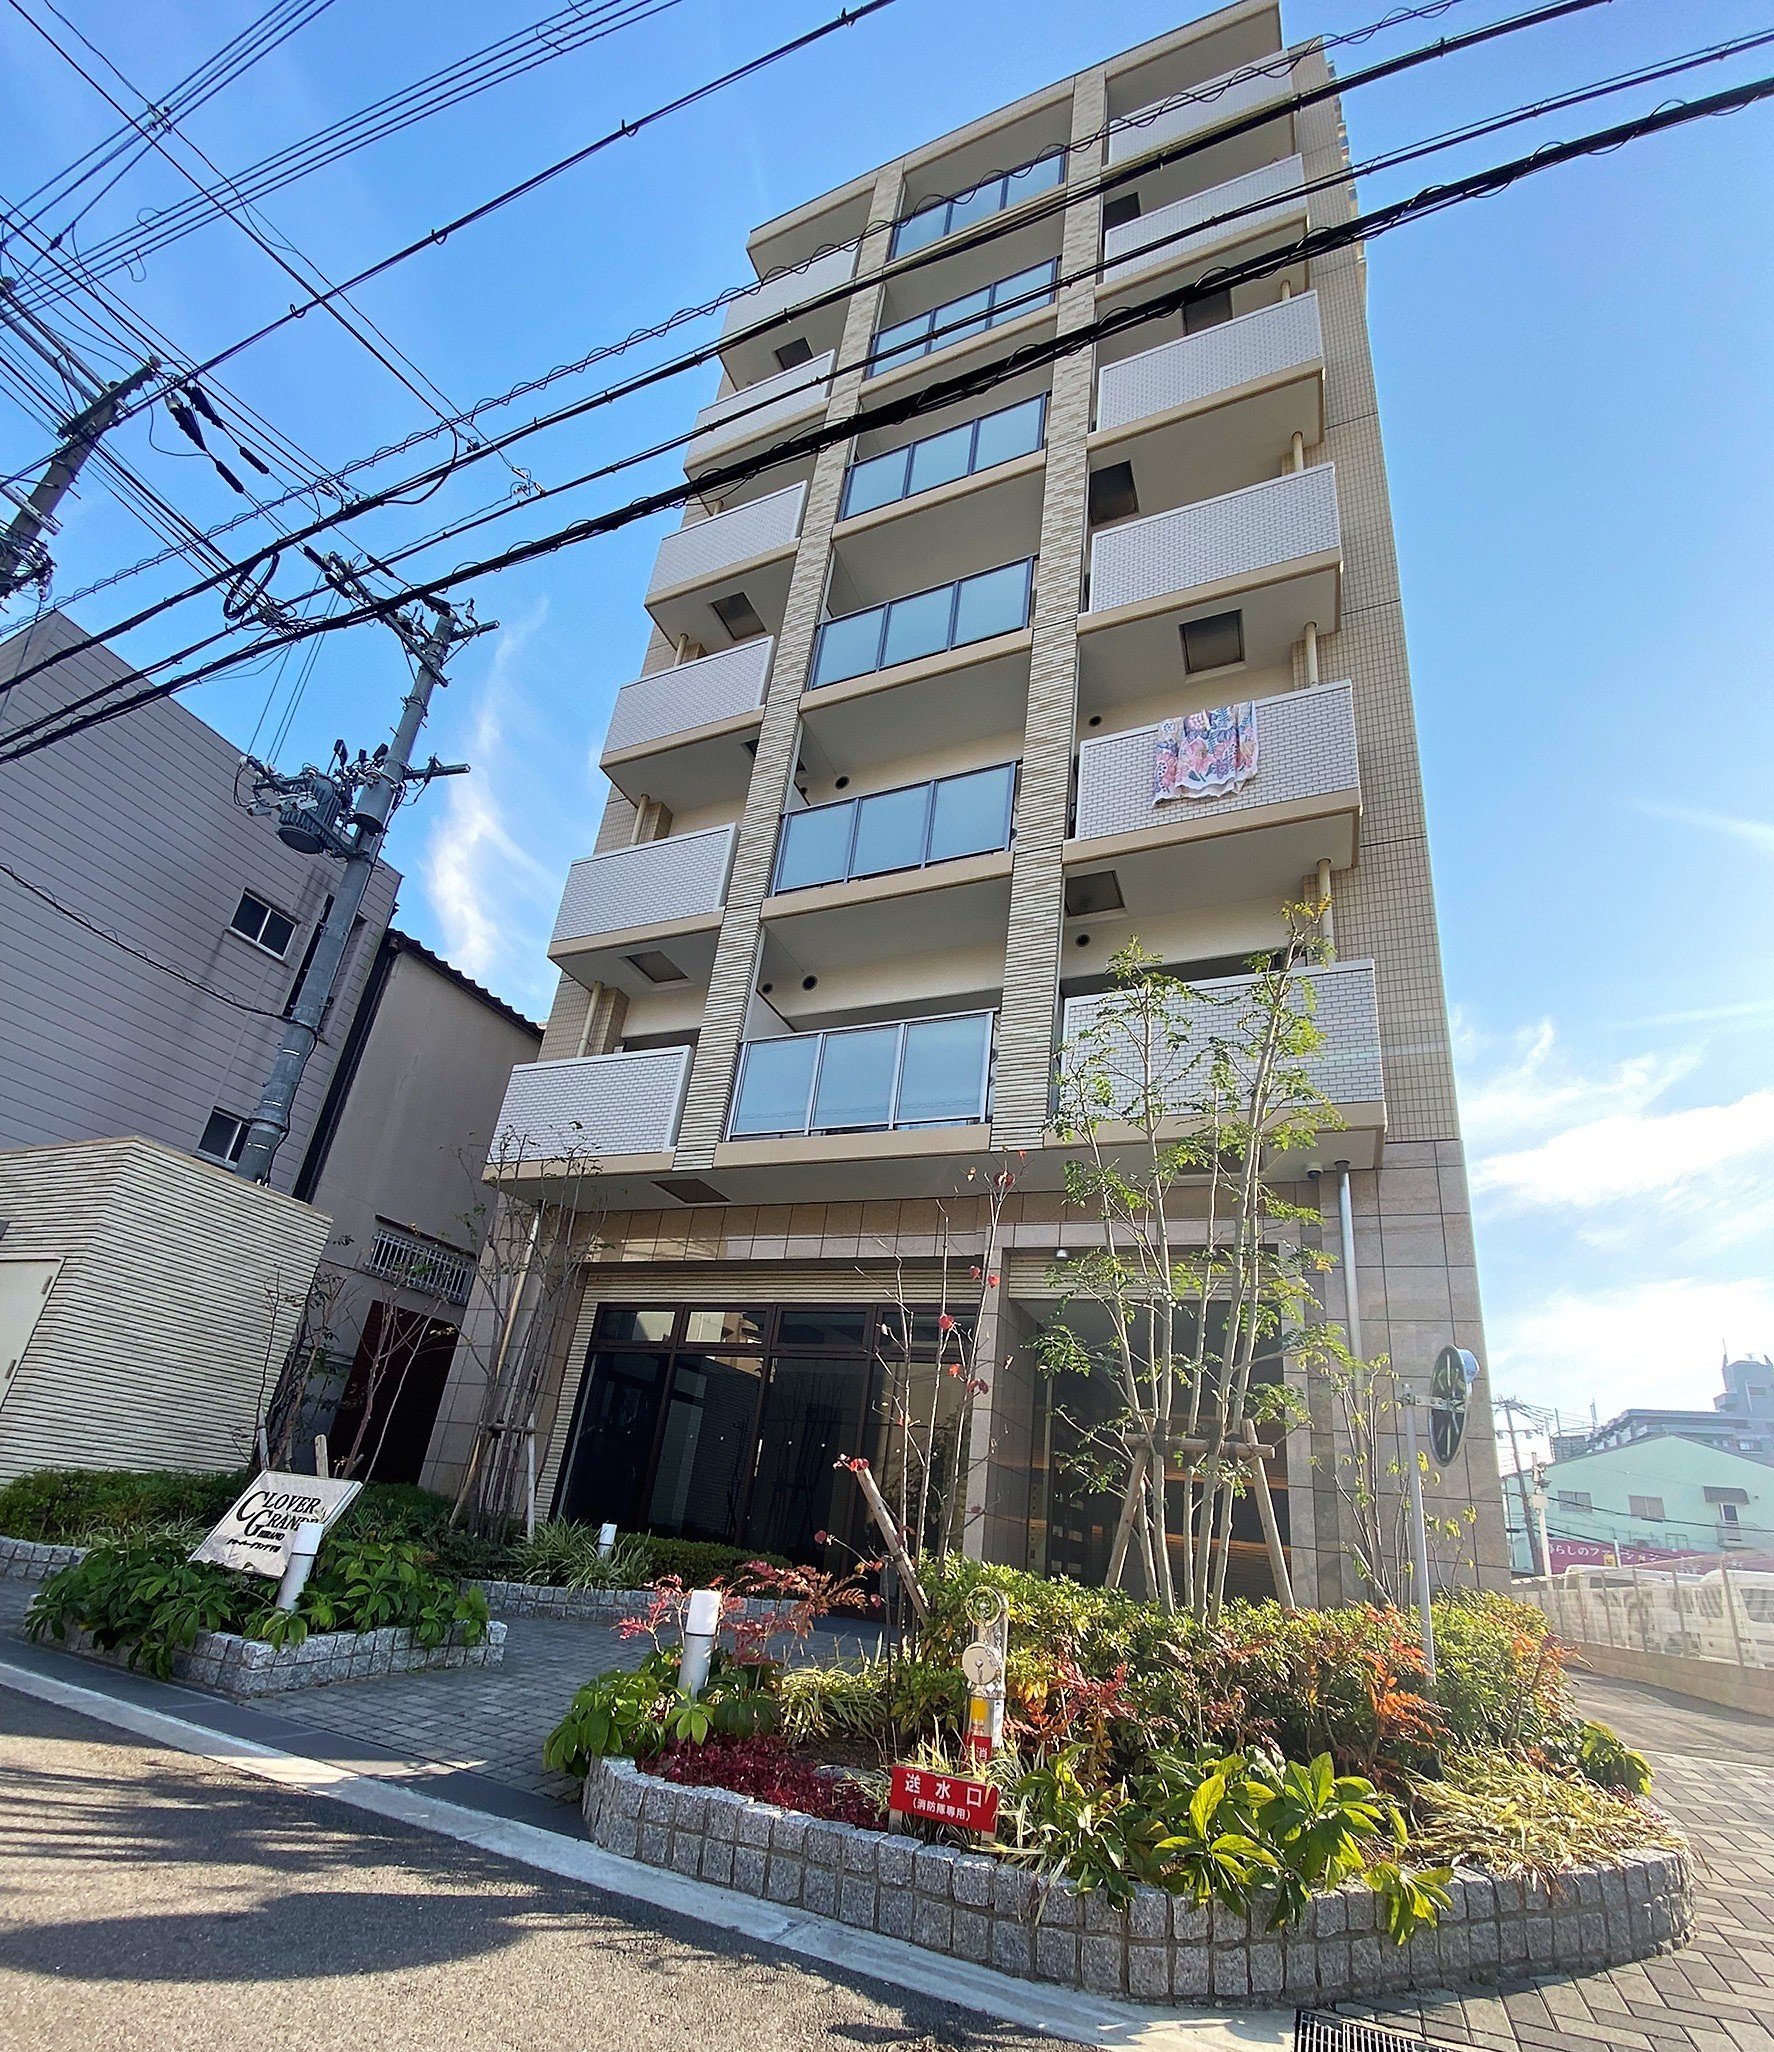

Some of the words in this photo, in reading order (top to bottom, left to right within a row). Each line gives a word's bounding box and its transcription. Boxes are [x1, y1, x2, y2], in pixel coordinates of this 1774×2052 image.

[236, 1490, 321, 1521] CLOVER
[243, 1509, 319, 1537] GRAN
[904, 1772, 982, 1808] 送水口
